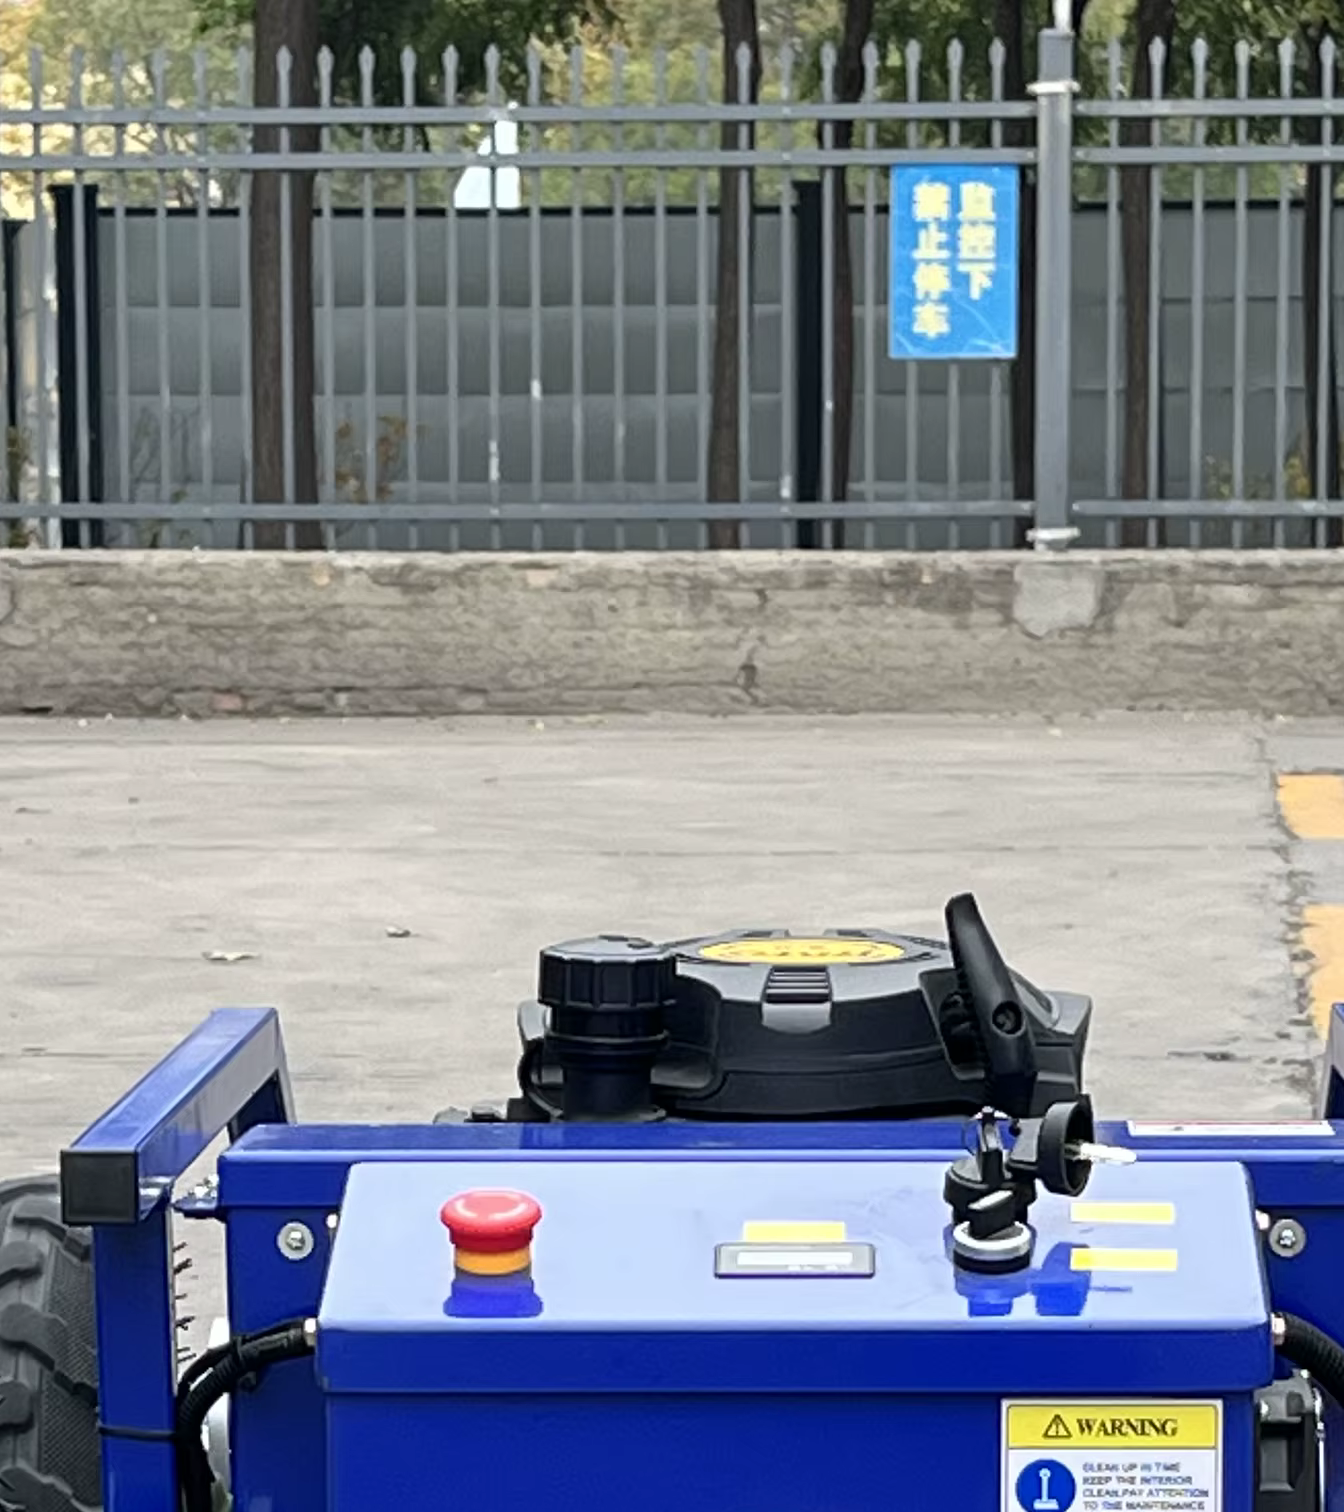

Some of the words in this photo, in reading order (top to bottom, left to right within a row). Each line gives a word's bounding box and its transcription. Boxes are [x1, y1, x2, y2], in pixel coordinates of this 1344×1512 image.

[957, 182, 996, 300] 监控下
[912, 182, 950, 338] 禁止停车
[1076, 1418, 1178, 1437] WARNING
[1083, 1462, 1120, 1472] CLEAN
[1122, 1462, 1138, 1472] UP
[1083, 1476, 1112, 1485] KEEP
[1116, 1476, 1136, 1485] THE
[1140, 1476, 1192, 1485] INTERIOR
[1146, 1488, 1209, 1498] ATTENTION
[1084, 1501, 1098, 1510] TO
[1102, 1501, 1122, 1510] THE
[1126, 1501, 1205, 1510] MAINTENANCE
